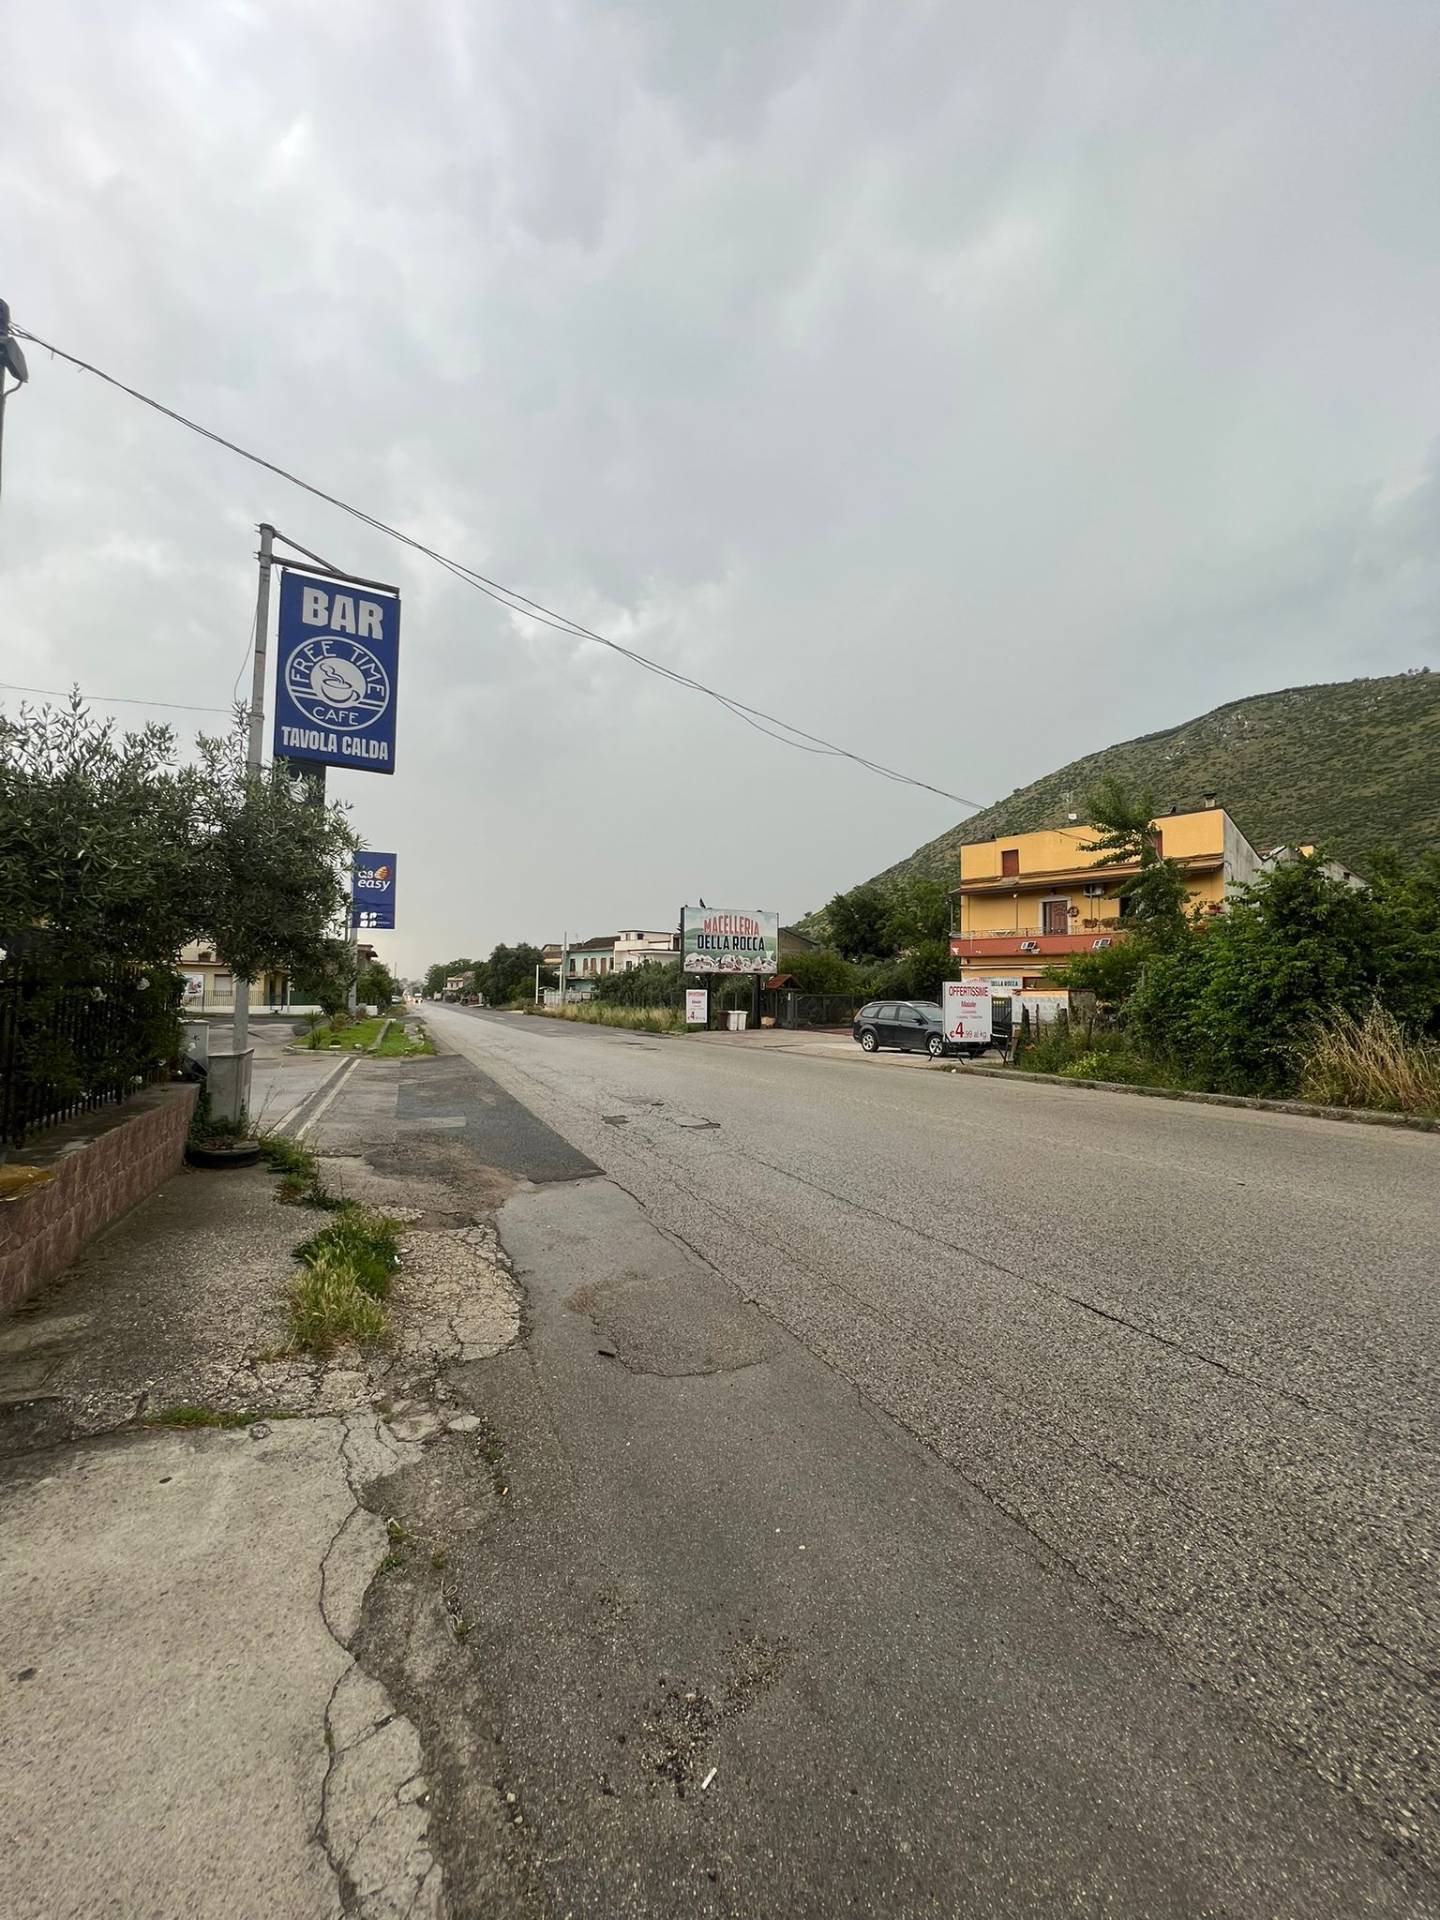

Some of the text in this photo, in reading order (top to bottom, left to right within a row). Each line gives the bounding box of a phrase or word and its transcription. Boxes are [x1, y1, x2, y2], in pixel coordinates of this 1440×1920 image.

[302, 587, 384, 640] BAR
[291, 640, 385, 698] FREE TIME
[313, 706, 359, 726] CAFE
[281, 726, 389, 760] TAVOLA CALDA
[358, 879, 391, 892] easy
[704, 915, 760, 936] MACELLERIA
[698, 936, 765, 951] DELLA ROCCA
[949, 986, 989, 997] OFFERTISSIME
